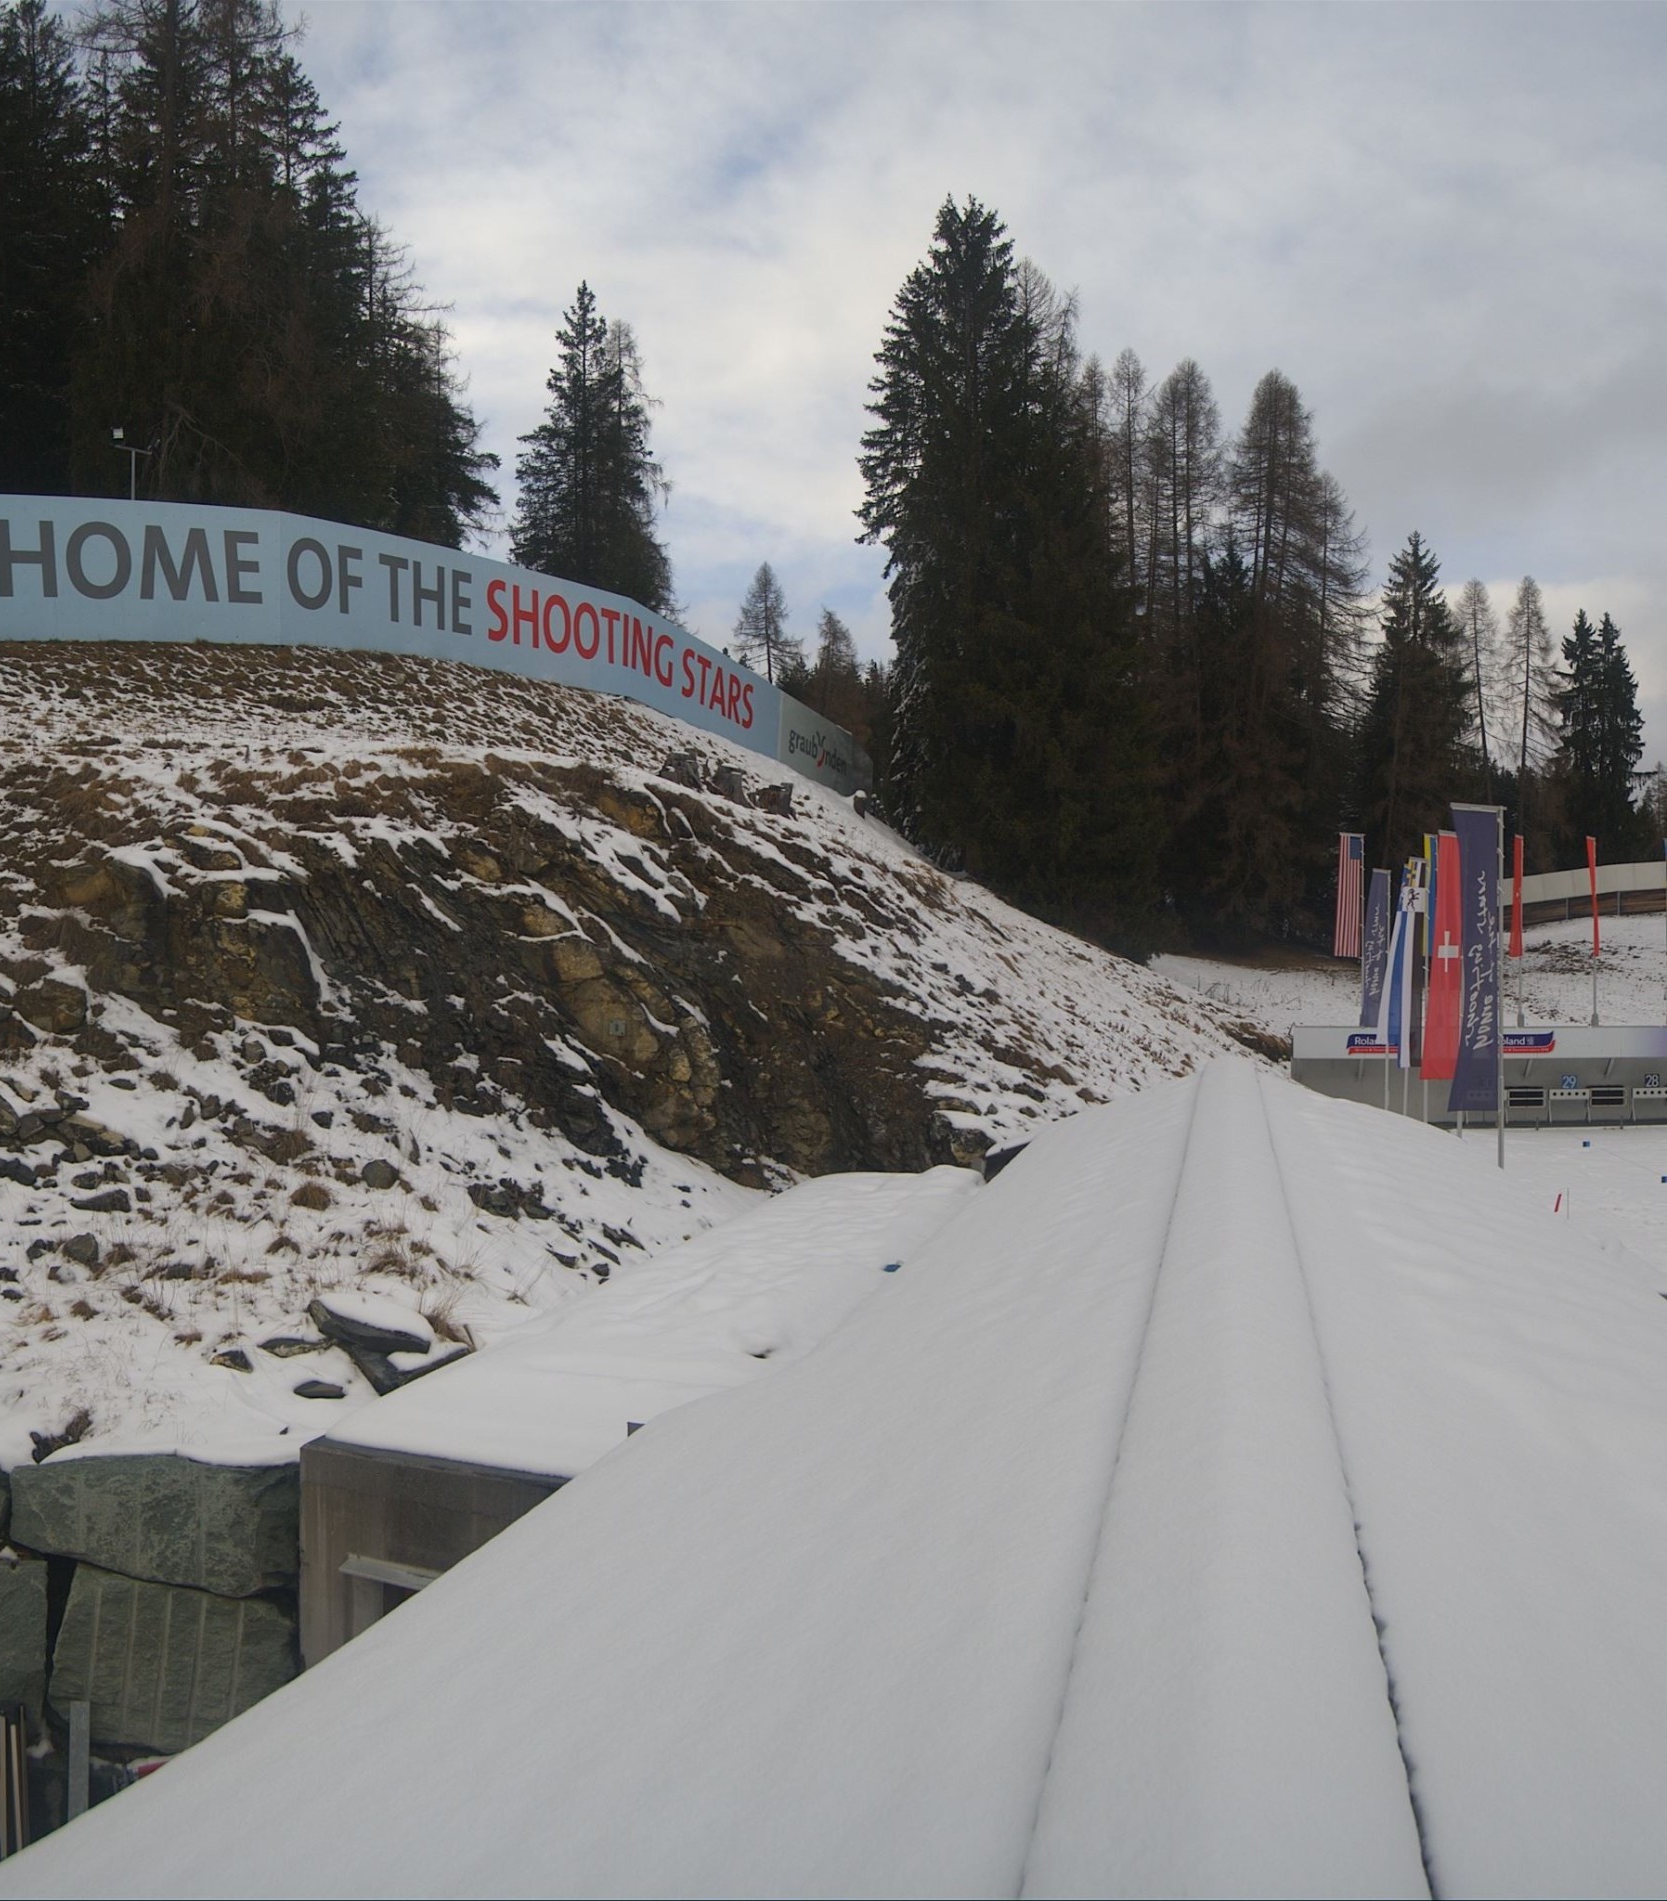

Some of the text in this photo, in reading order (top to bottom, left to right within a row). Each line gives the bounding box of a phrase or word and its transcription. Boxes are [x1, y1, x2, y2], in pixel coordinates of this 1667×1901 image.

[286, 536, 363, 615] OF
[378, 552, 473, 636] THE
[485, 578, 675, 688] SHOOTING
[680, 647, 755, 731] STARS
[1562, 1075, 1577, 1089] 29
[1645, 1074, 1659, 1088] 28
